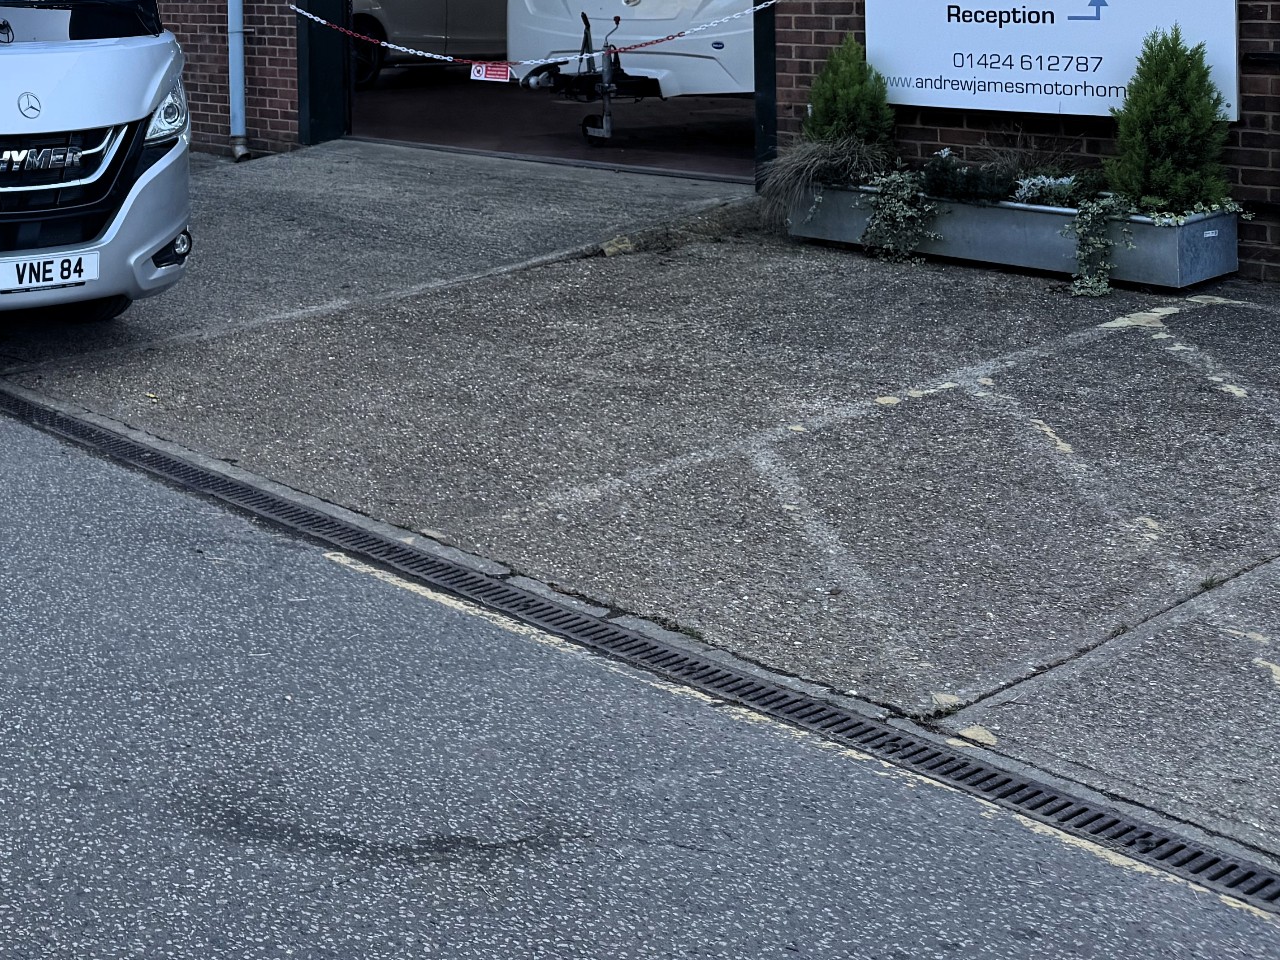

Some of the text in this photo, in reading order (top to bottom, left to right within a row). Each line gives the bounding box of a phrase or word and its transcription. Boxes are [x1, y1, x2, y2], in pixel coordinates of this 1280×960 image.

[946, 4, 1055, 28] Reception
[952, 52, 1103, 72] 01424 612787
[880, 74, 1127, 98] www.andrewjamesmotorhom
[15, 257, 84, 285] VNE 84
